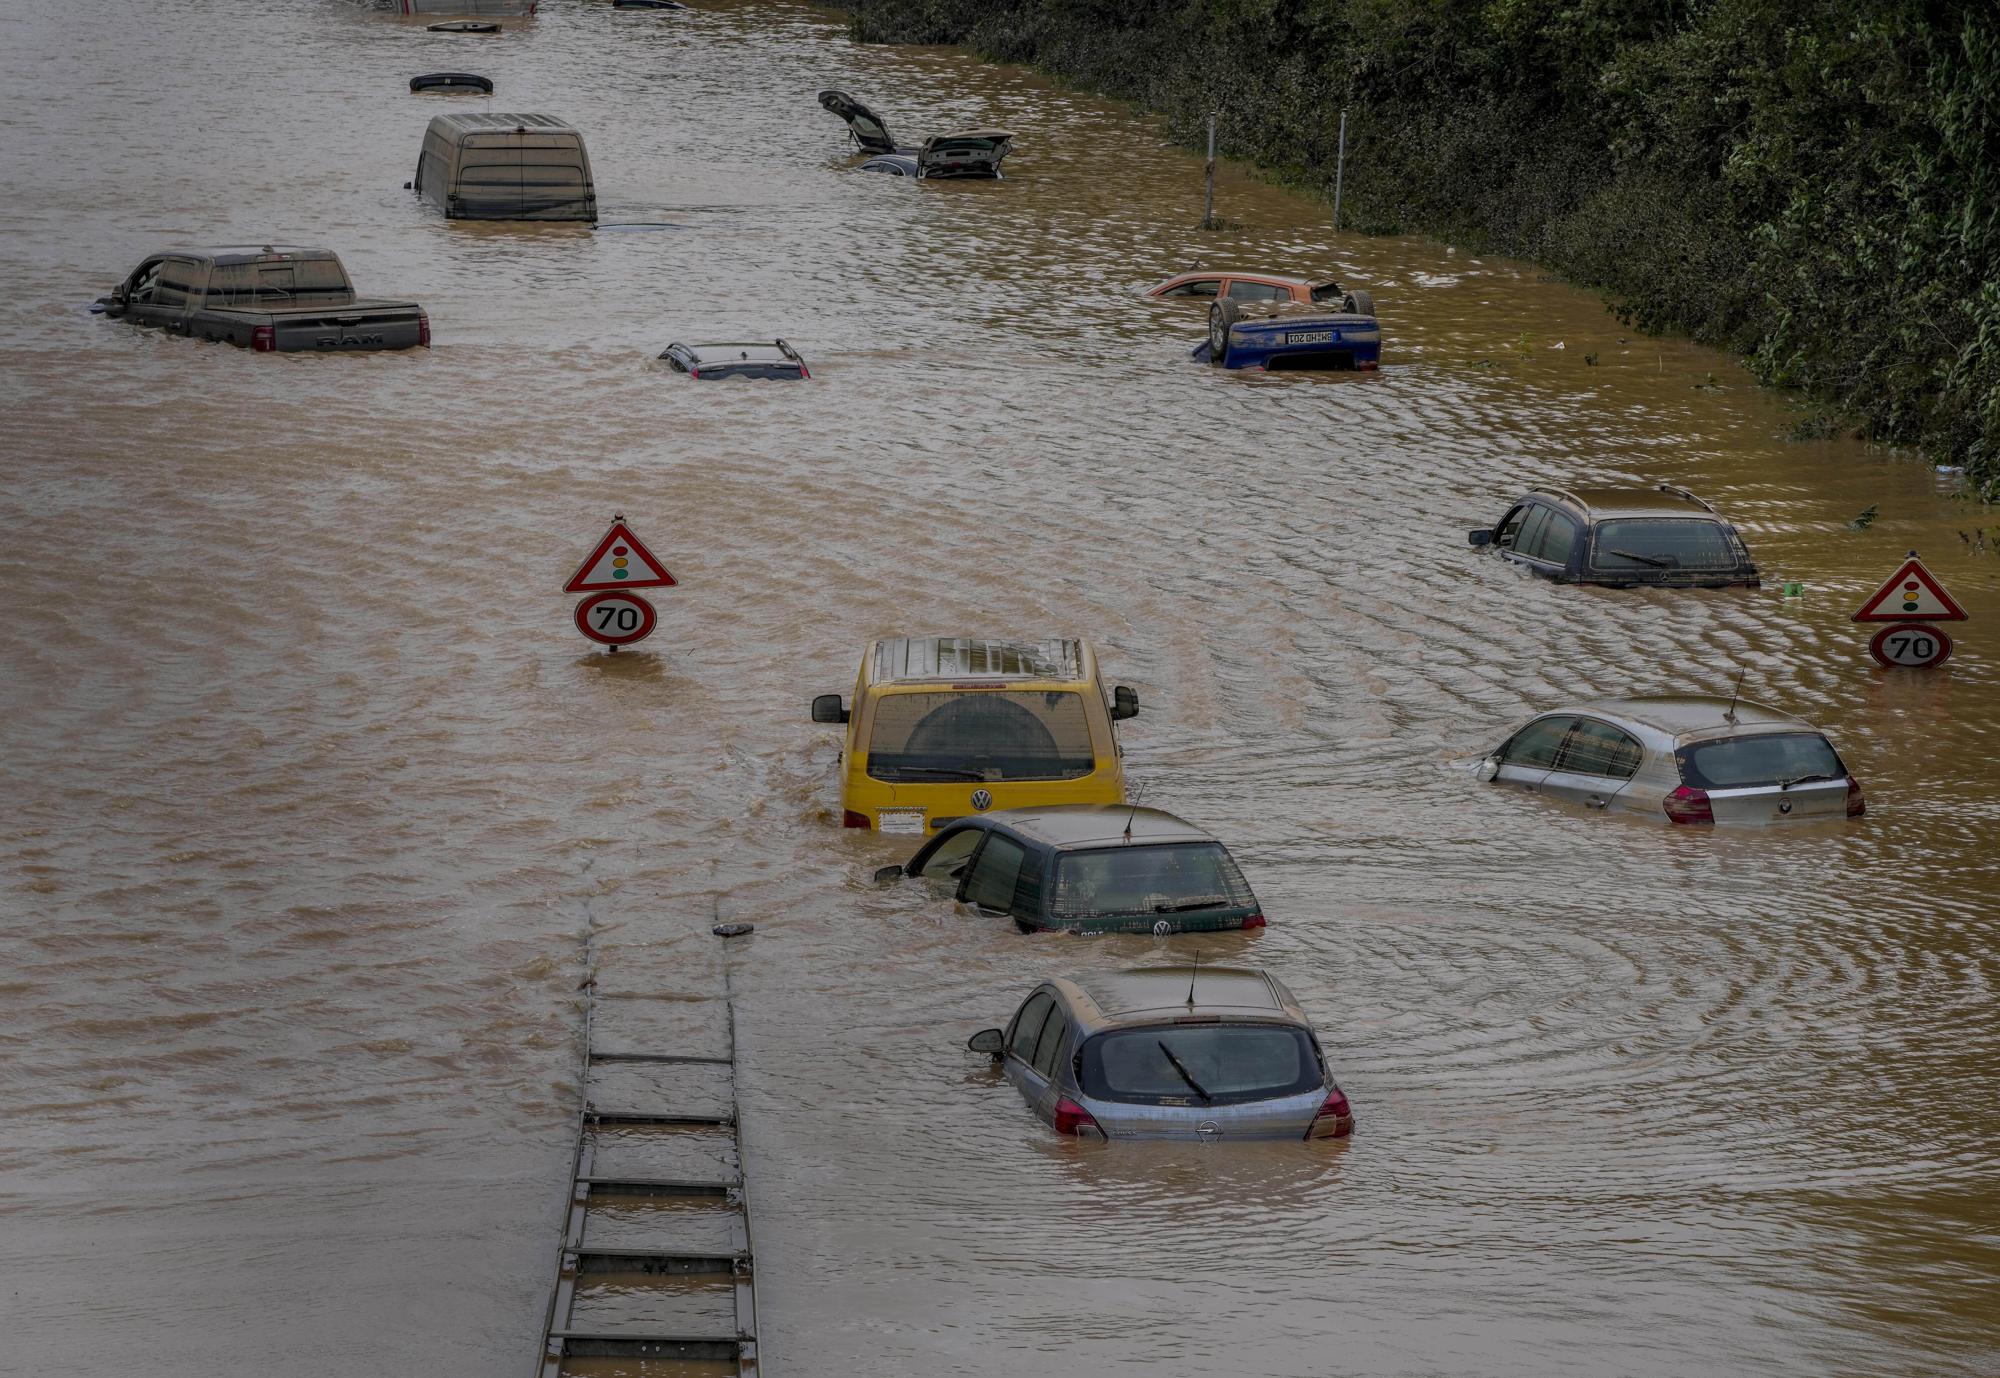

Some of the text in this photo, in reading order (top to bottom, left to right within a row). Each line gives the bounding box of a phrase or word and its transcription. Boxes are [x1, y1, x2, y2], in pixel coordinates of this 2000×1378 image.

[316, 333, 383, 346] RAM
[1289, 333, 1304, 343] 201
[596, 606, 638, 631] 70
[1890, 637, 1933, 659] 70
